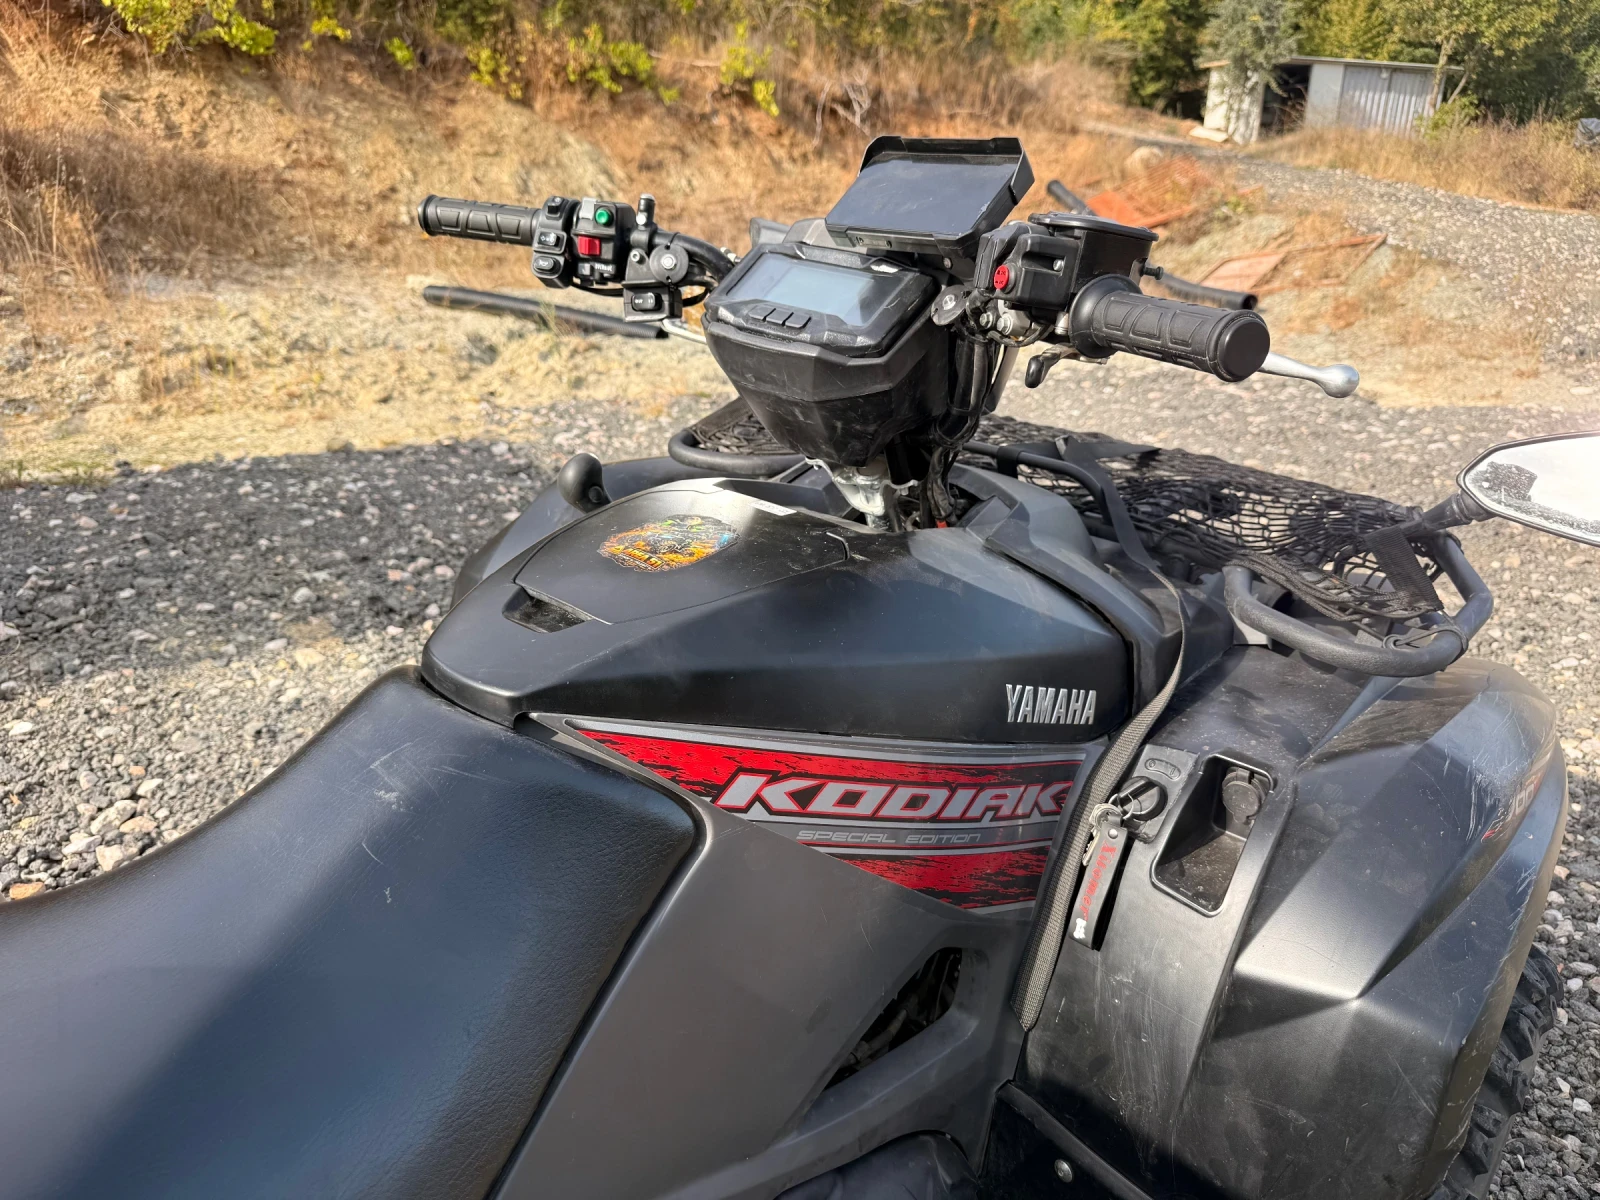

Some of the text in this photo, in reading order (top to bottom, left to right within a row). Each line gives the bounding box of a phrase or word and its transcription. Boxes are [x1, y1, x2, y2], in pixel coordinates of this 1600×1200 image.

[1005, 684, 1096, 725] YAMAHA
[715, 773, 1074, 820] KODIAK
[796, 830, 981, 844] SPECIAL EDITION
